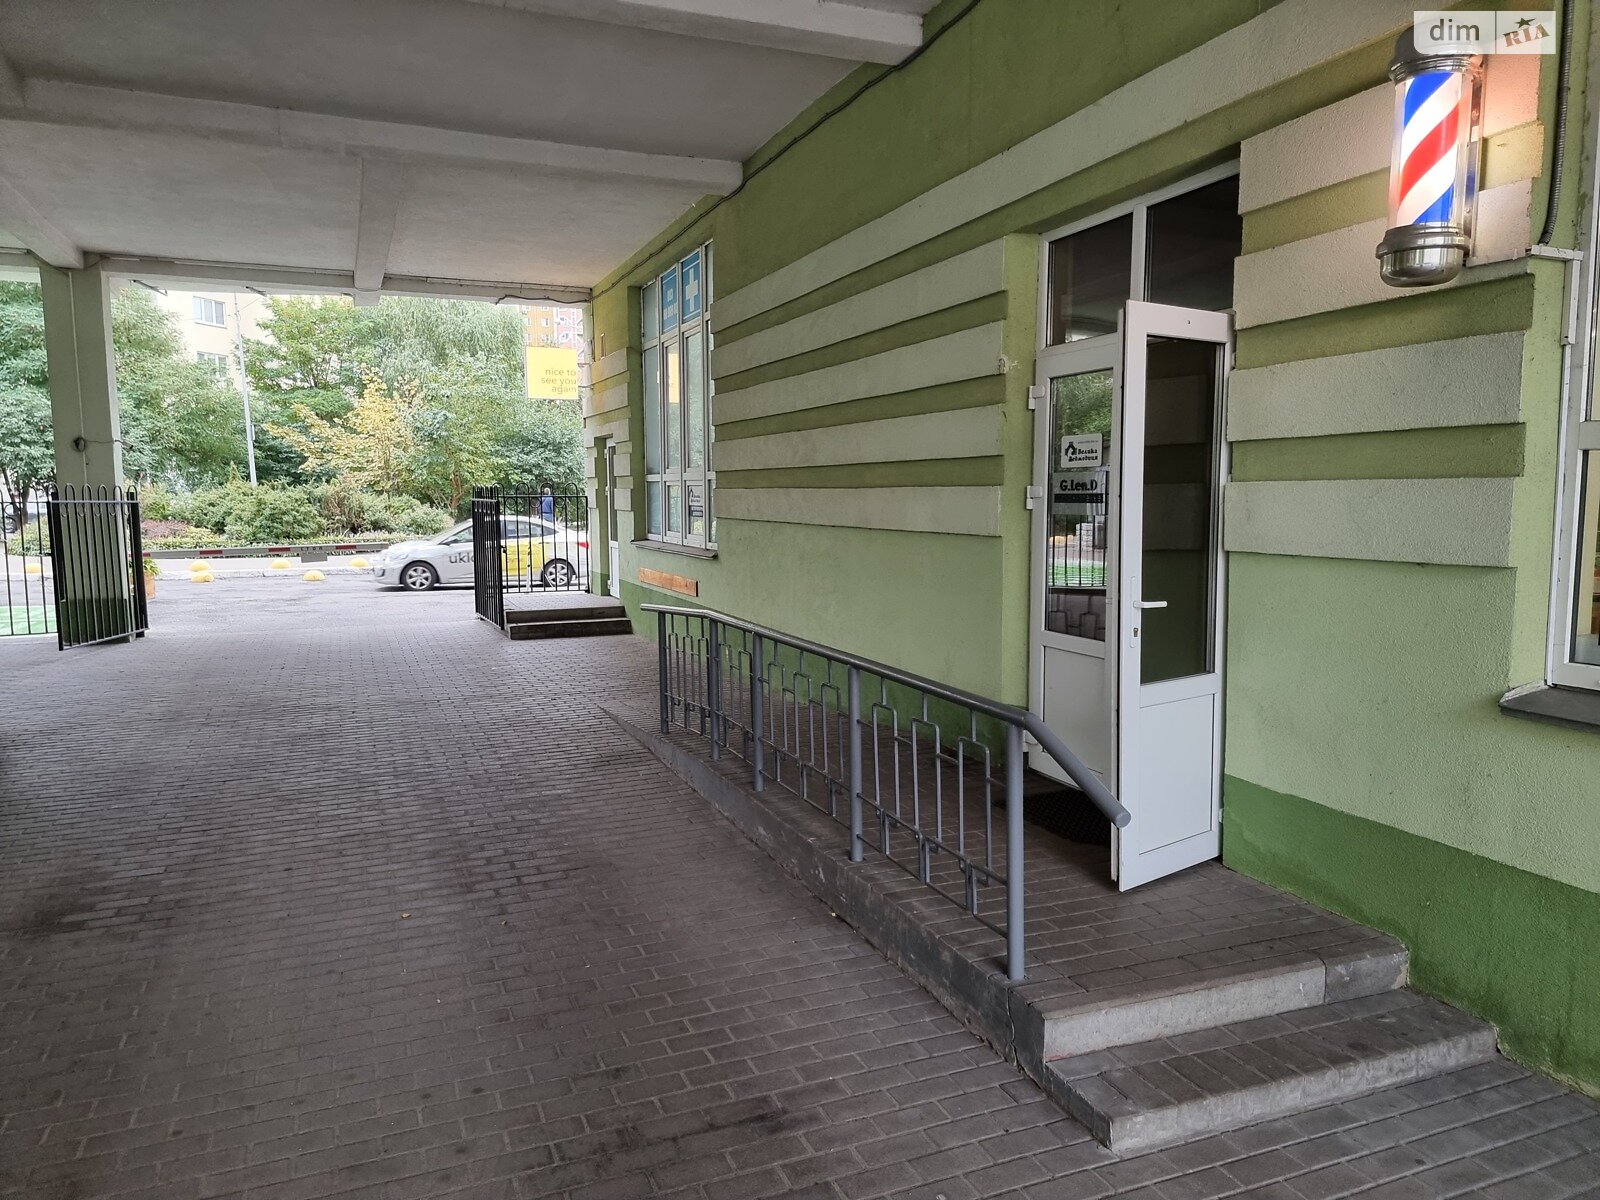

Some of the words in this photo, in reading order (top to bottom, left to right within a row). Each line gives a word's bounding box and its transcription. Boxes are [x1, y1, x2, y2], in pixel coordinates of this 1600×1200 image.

[545, 368, 565, 376] nice
[559, 378, 577, 387] you
[551, 387, 577, 395] again
